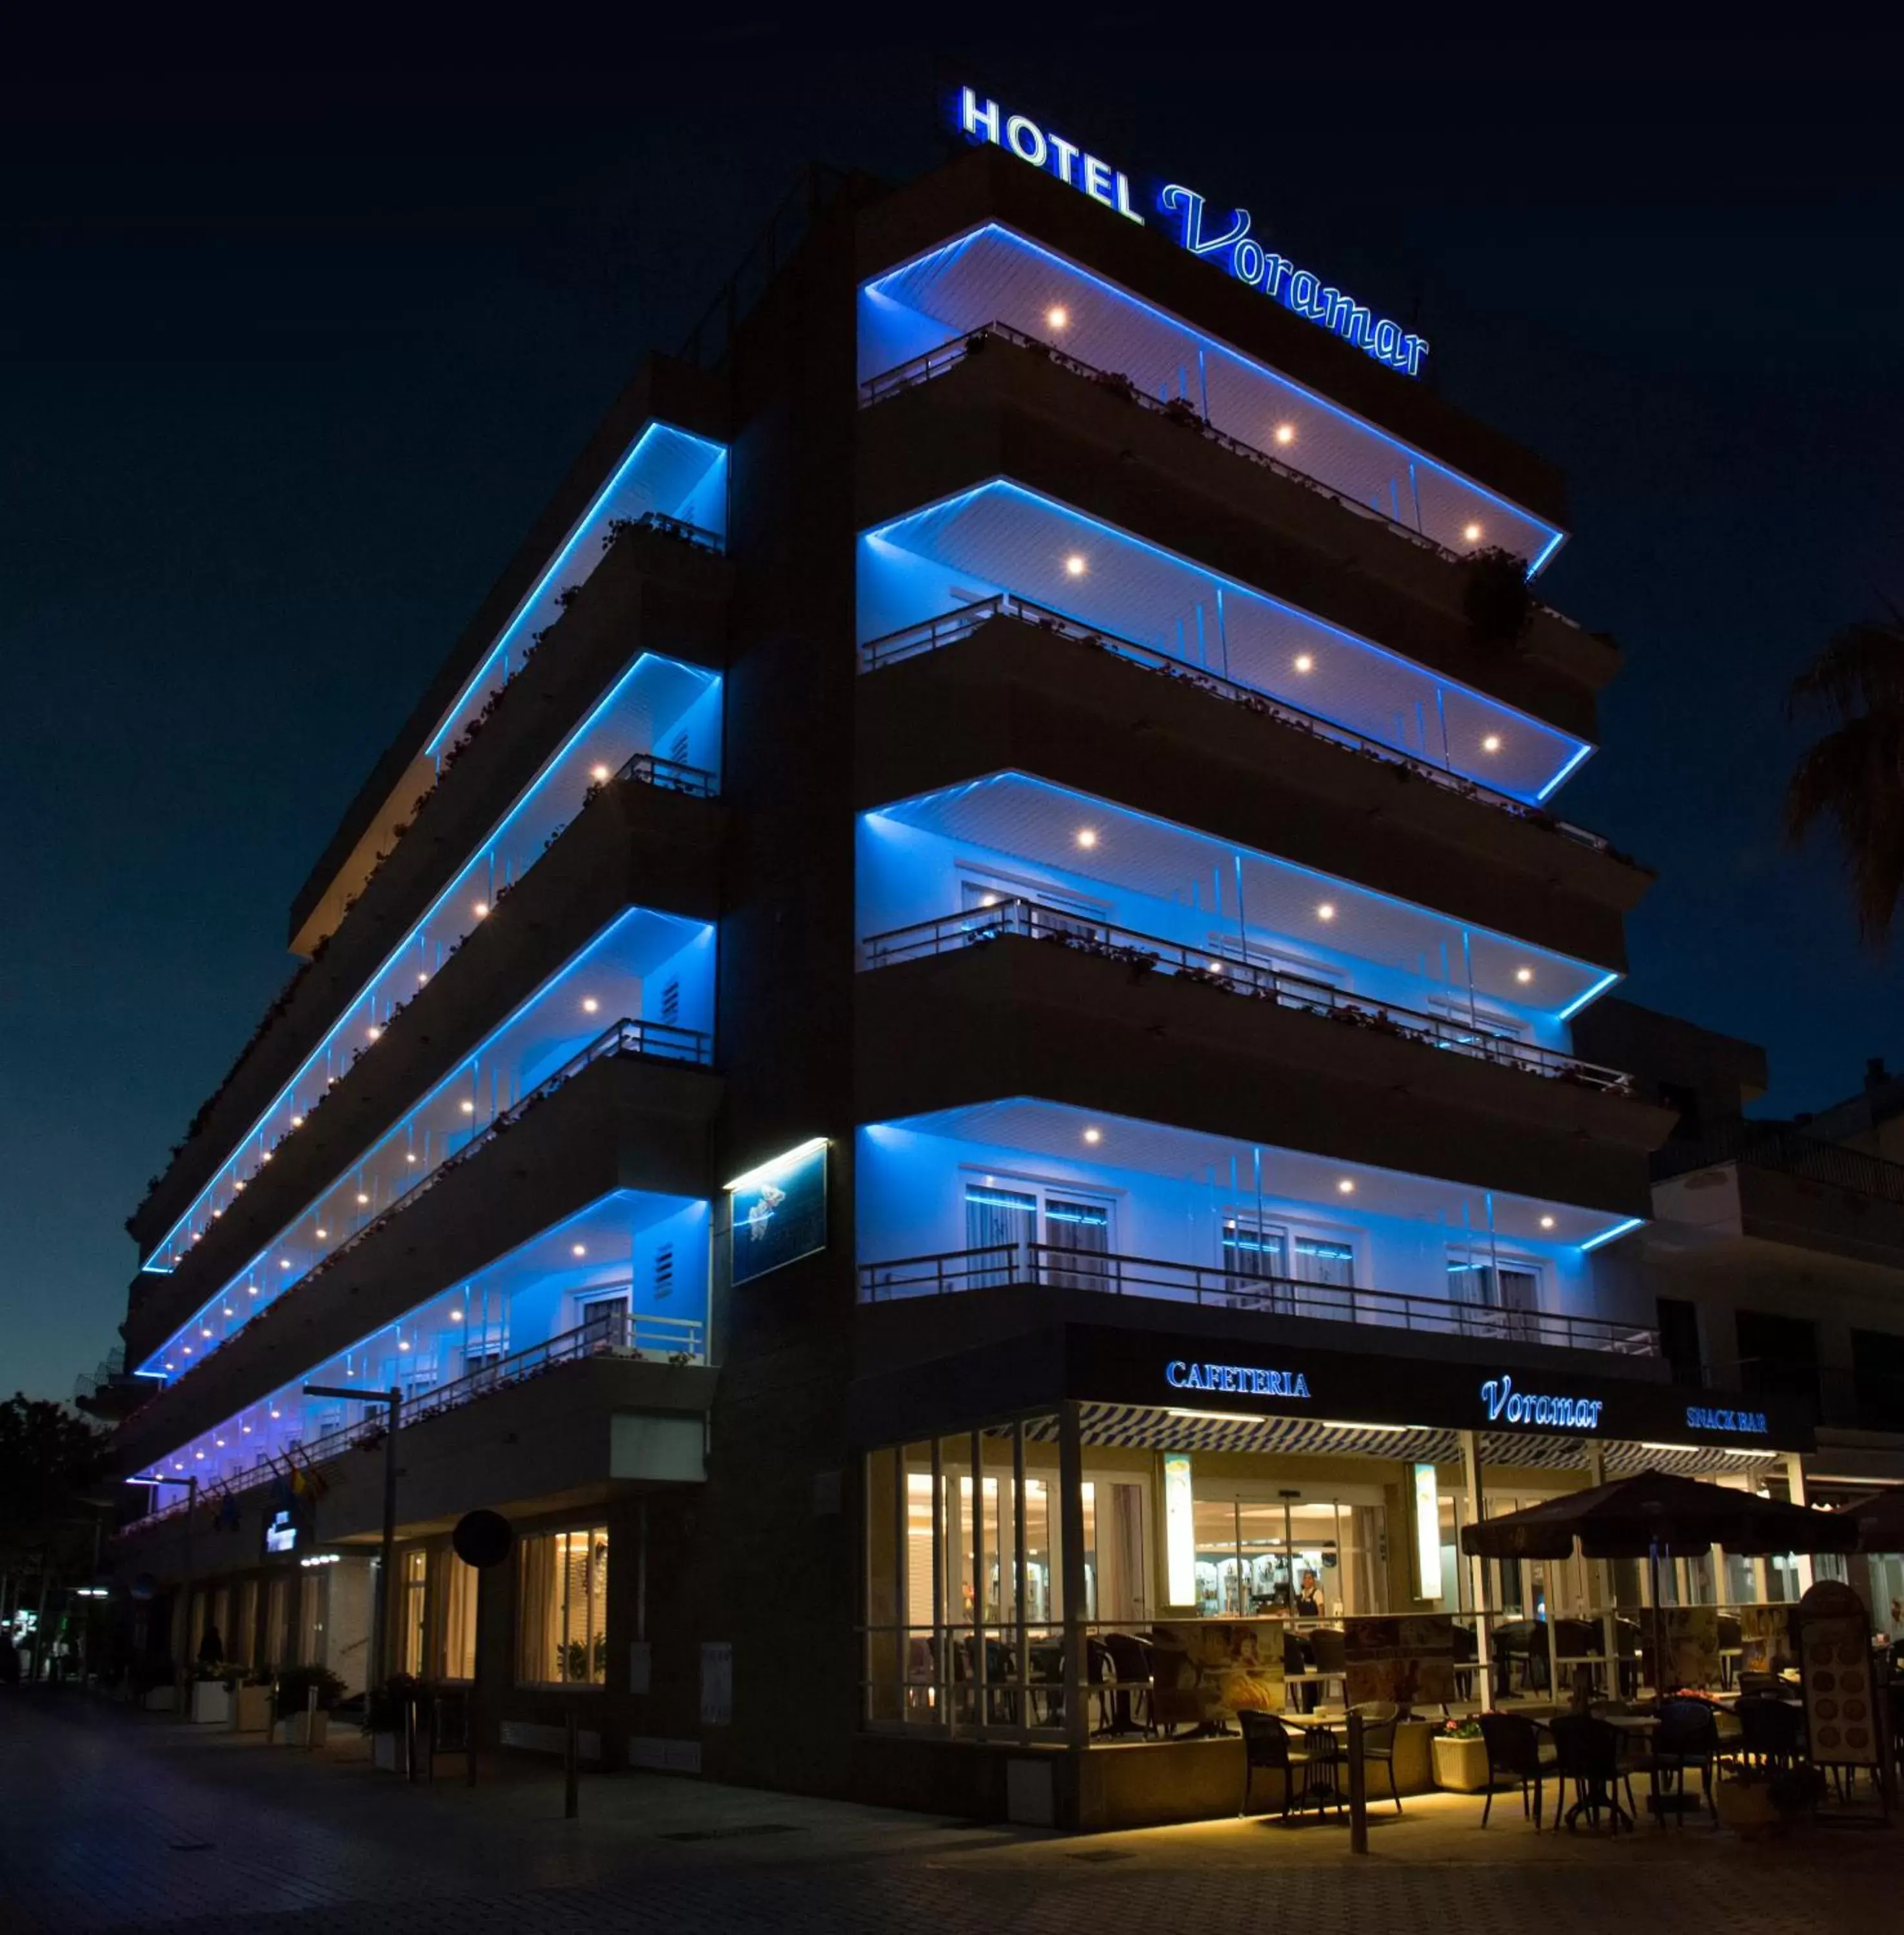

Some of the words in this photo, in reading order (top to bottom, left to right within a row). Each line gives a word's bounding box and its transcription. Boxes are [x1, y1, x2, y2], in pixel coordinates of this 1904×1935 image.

[962, 86, 1144, 226] HOTEL
[1162, 184, 1429, 377] Voramar
[1165, 1360, 1311, 1398] CAFETERIA
[1482, 1375, 1602, 1428] Voramar
[1686, 1406, 1737, 1431] SNACK
[1737, 1411, 1768, 1433] BAR
